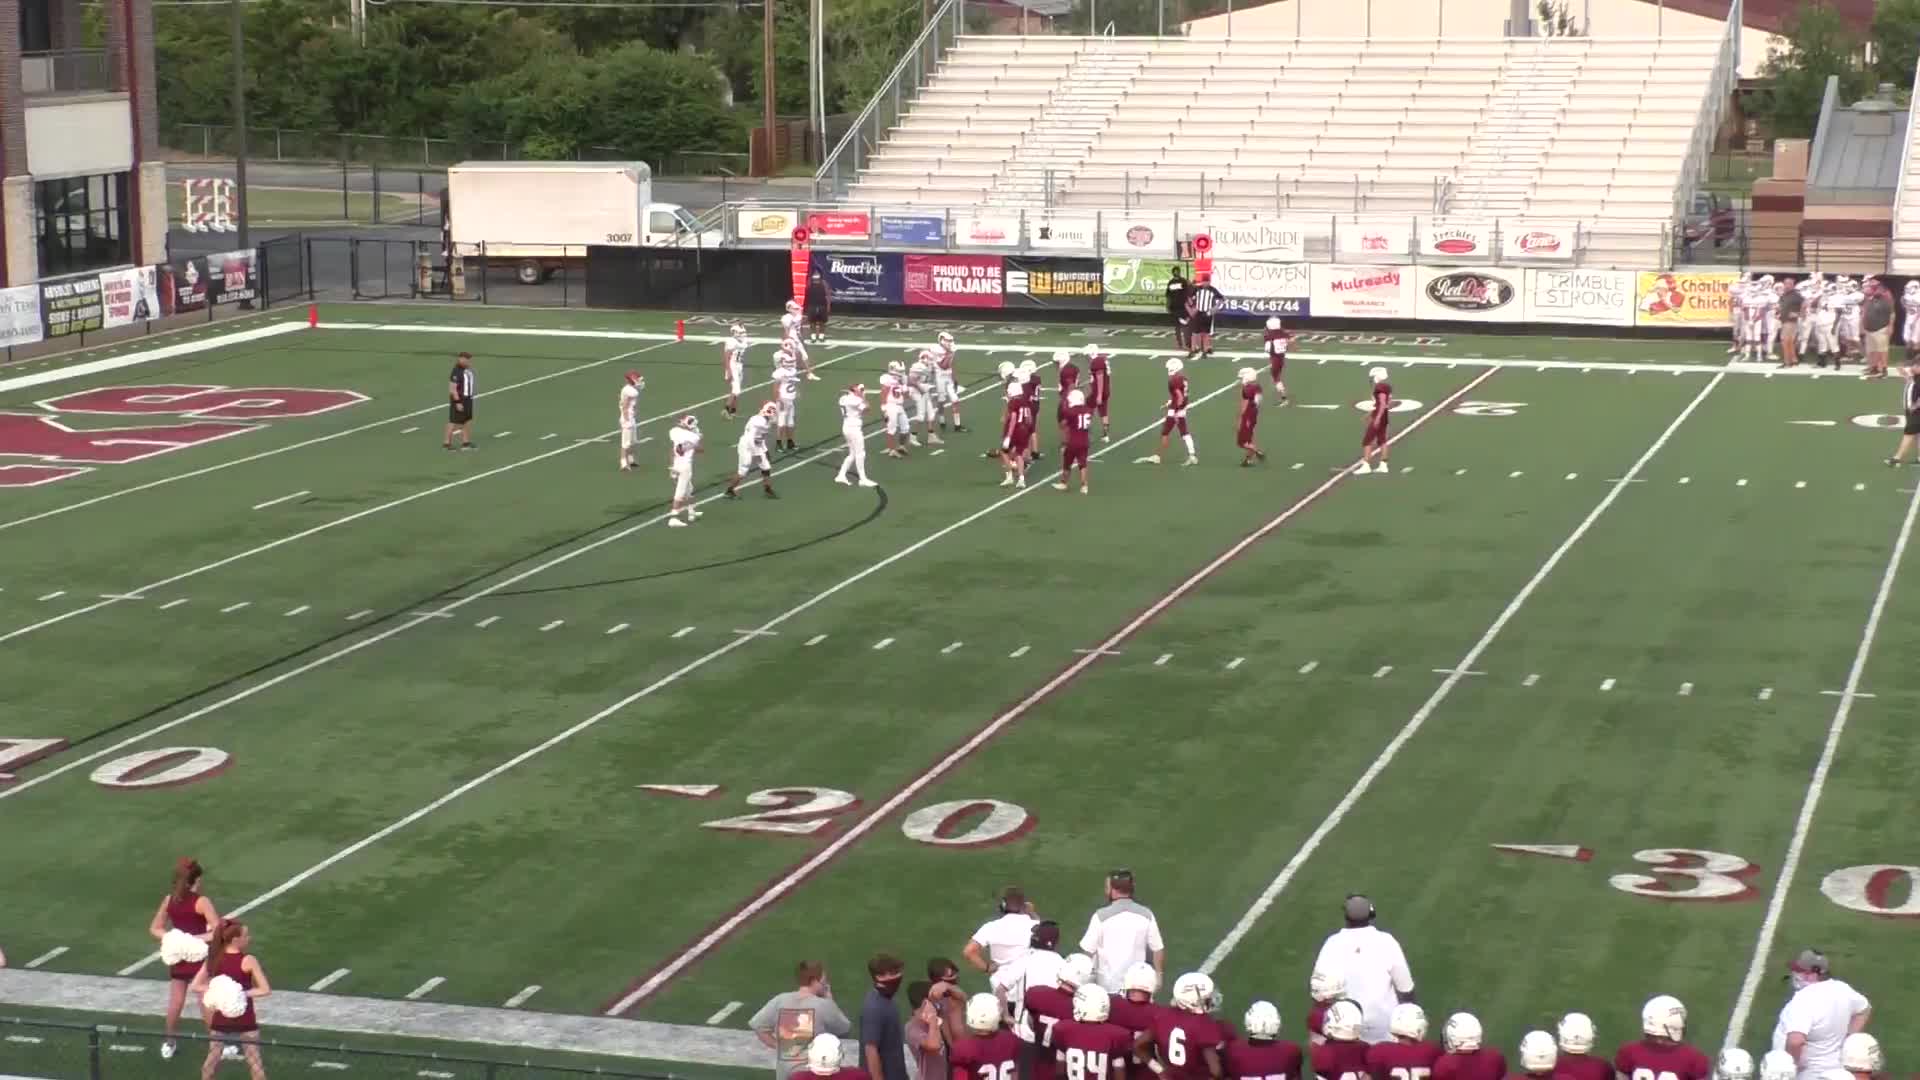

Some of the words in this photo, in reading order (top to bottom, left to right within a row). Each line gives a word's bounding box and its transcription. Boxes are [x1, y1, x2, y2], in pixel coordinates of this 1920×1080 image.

[1260, 226, 1300, 245] PRIDE
[933, 265, 968, 277] PROUD
[971, 266, 984, 277] TO
[987, 267, 1001, 278] BE
[934, 277, 1002, 294] TROJANS
[1053, 280, 1101, 295] WORLD
[1330, 271, 1400, 292] Mulready
[1547, 273, 1625, 290] TRIMBLE
[1546, 289, 1625, 307] STRONG
[1688, 295, 1731, 309] Chick
[1168, 1027, 1187, 1066] 6
[1066, 1048, 1108, 1080] 84
